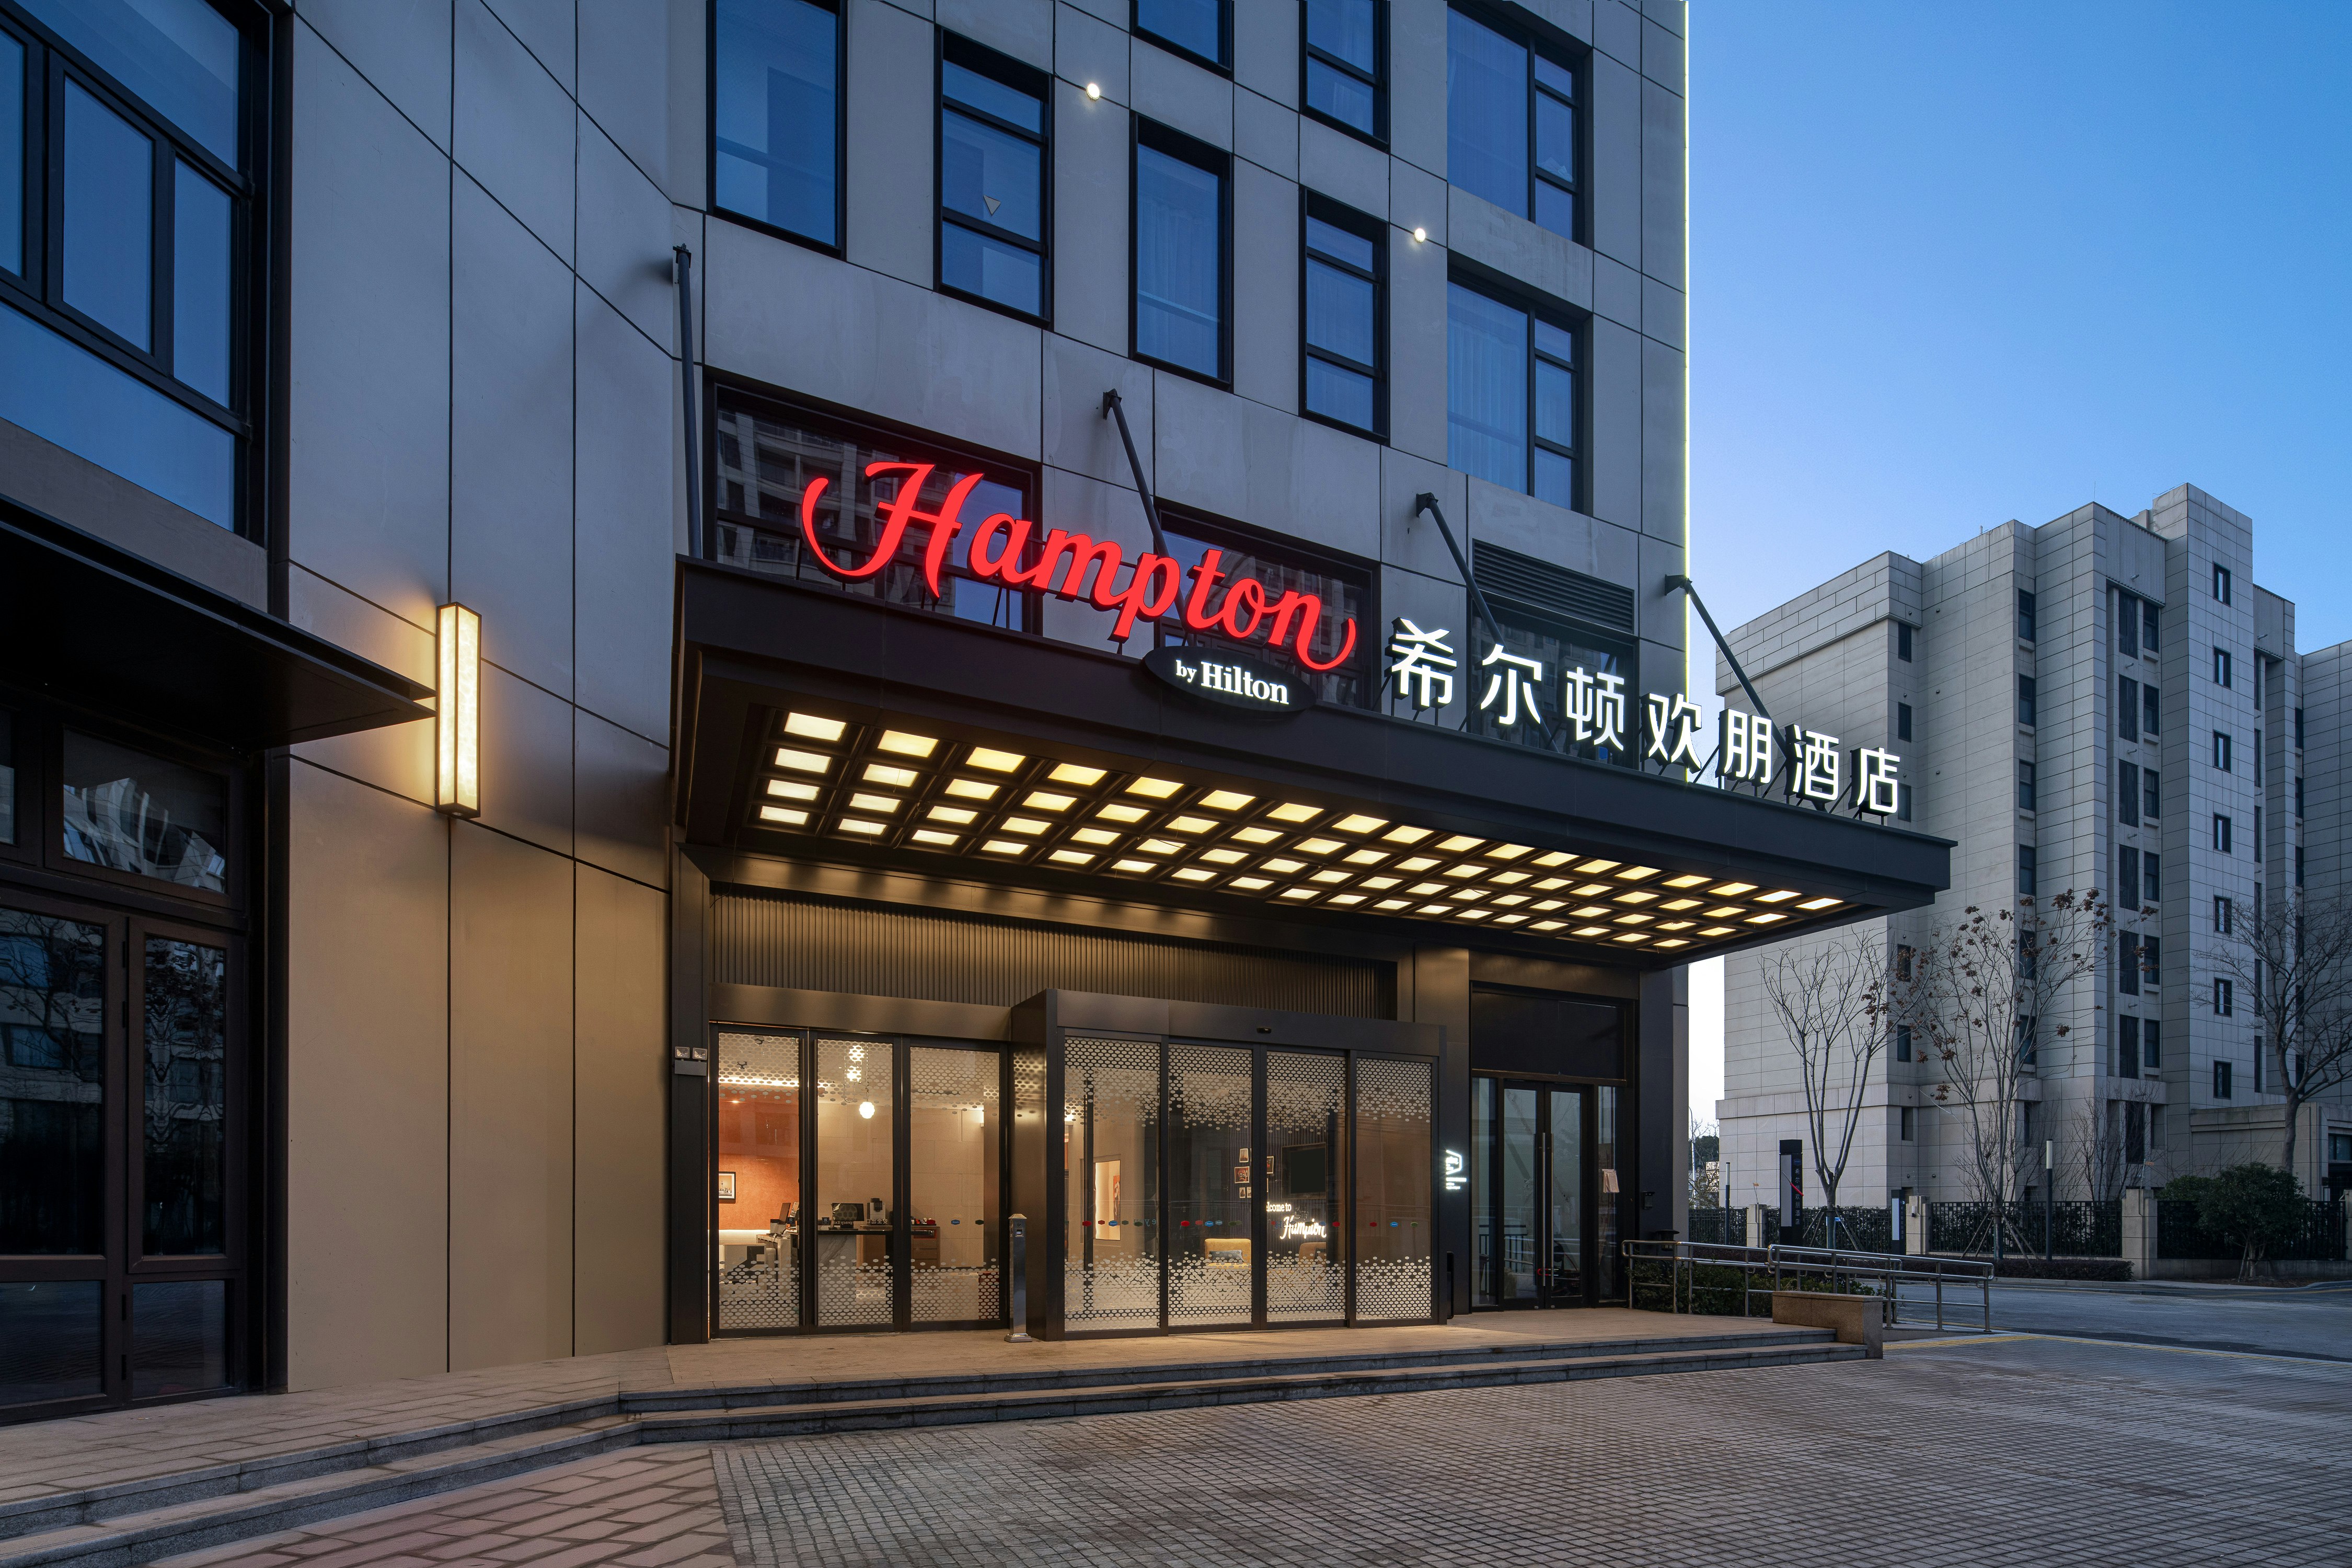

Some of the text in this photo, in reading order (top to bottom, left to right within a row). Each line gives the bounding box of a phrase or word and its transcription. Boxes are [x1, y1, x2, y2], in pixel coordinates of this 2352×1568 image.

[802, 462, 1356, 670] Hampton
[1175, 660, 1289, 705] by Hilton
[1390, 618, 1900, 814] 希尔顿欢朋酒店
[1266, 1202, 1292, 1212] lcome to
